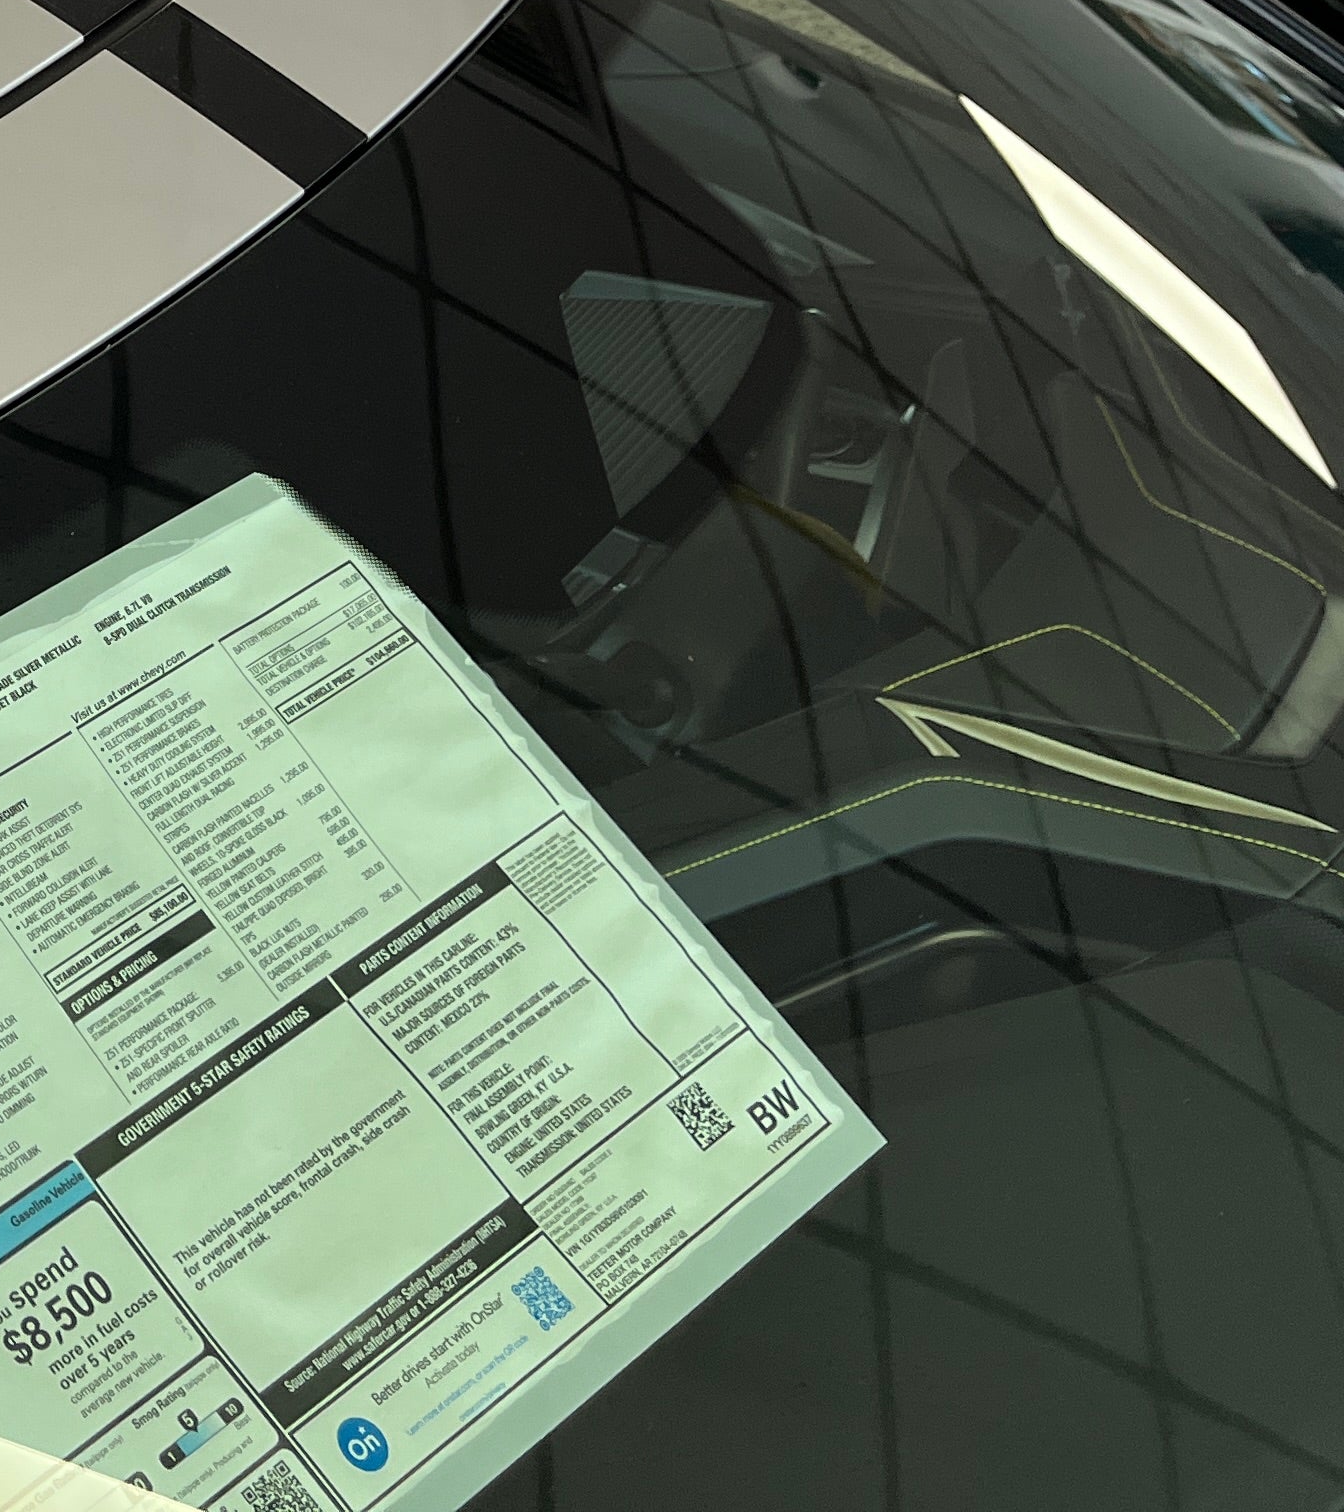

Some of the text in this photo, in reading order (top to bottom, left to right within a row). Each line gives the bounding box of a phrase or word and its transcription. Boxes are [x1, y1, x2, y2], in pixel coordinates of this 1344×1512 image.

[103, 565, 232, 646] 8-SPD DUAL CLUTCH TRANSMISSION
[9, 680, 38, 702] BLACK
[13, 659, 43, 681] SILVER
[40, 635, 82, 665] METALLIC
[70, 650, 187, 724] Visit us at www.chevy.com
[359, 883, 483, 975] PARTS CONTENT INFORMATION
[433, 964, 462, 989] PARTS
[458, 939, 499, 970] CONTENT:
[496, 922, 519, 941] 43%
[71, 950, 158, 1014] OPTIONS & PRICING
[362, 933, 479, 1019] FOR VEHICLES IN THIS CARLINE:
[391, 941, 526, 1042] MAJOR SOURCES OF FOREIGN PARTS
[404, 990, 490, 1054] CONTENT: MEXICO 23%
[118, 1006, 310, 1146] GOVERNMENT 5-STAR SAFETY RATINGS
[446, 1063, 515, 1115] FOR THIS VEHICLE:
[463, 1055, 553, 1125] FINAL ASSEMBLY POINT:
[474, 1109, 511, 1140] BOWLING
[507, 1089, 540, 1115] GREEN,
[534, 1078, 549, 1095] KY
[746, 1079, 799, 1135] BW
[486, 1094, 562, 1154] COUNTRY OF ORIGIN:
[504, 1093, 592, 1164] ENGINE: UNITED STATES
[515, 1085, 632, 1178] TRANSMISSION: UNITED STATES
[10, 1170, 86, 1227] Gasoline Vehicle
[172, 1089, 406, 1265] This vehicle has not been rated by the government
[183, 1106, 411, 1279] for overall vehicle score, frontal crash, side crash
[9, 1247, 79, 1312] spend
[195, 1232, 271, 1291] or rollover risk.
[3, 1271, 111, 1366] $8,500
[48, 1290, 158, 1375] more in fuel costs
[60, 1330, 135, 1390] over 5 years
[70, 1351, 138, 1404] compared to the
[80, 1352, 166, 1419] average new vehicle.
[371, 1378, 403, 1406] Better
[401, 1356, 432, 1383] drives
[429, 1337, 454, 1361] start
[450, 1321, 475, 1343] with
